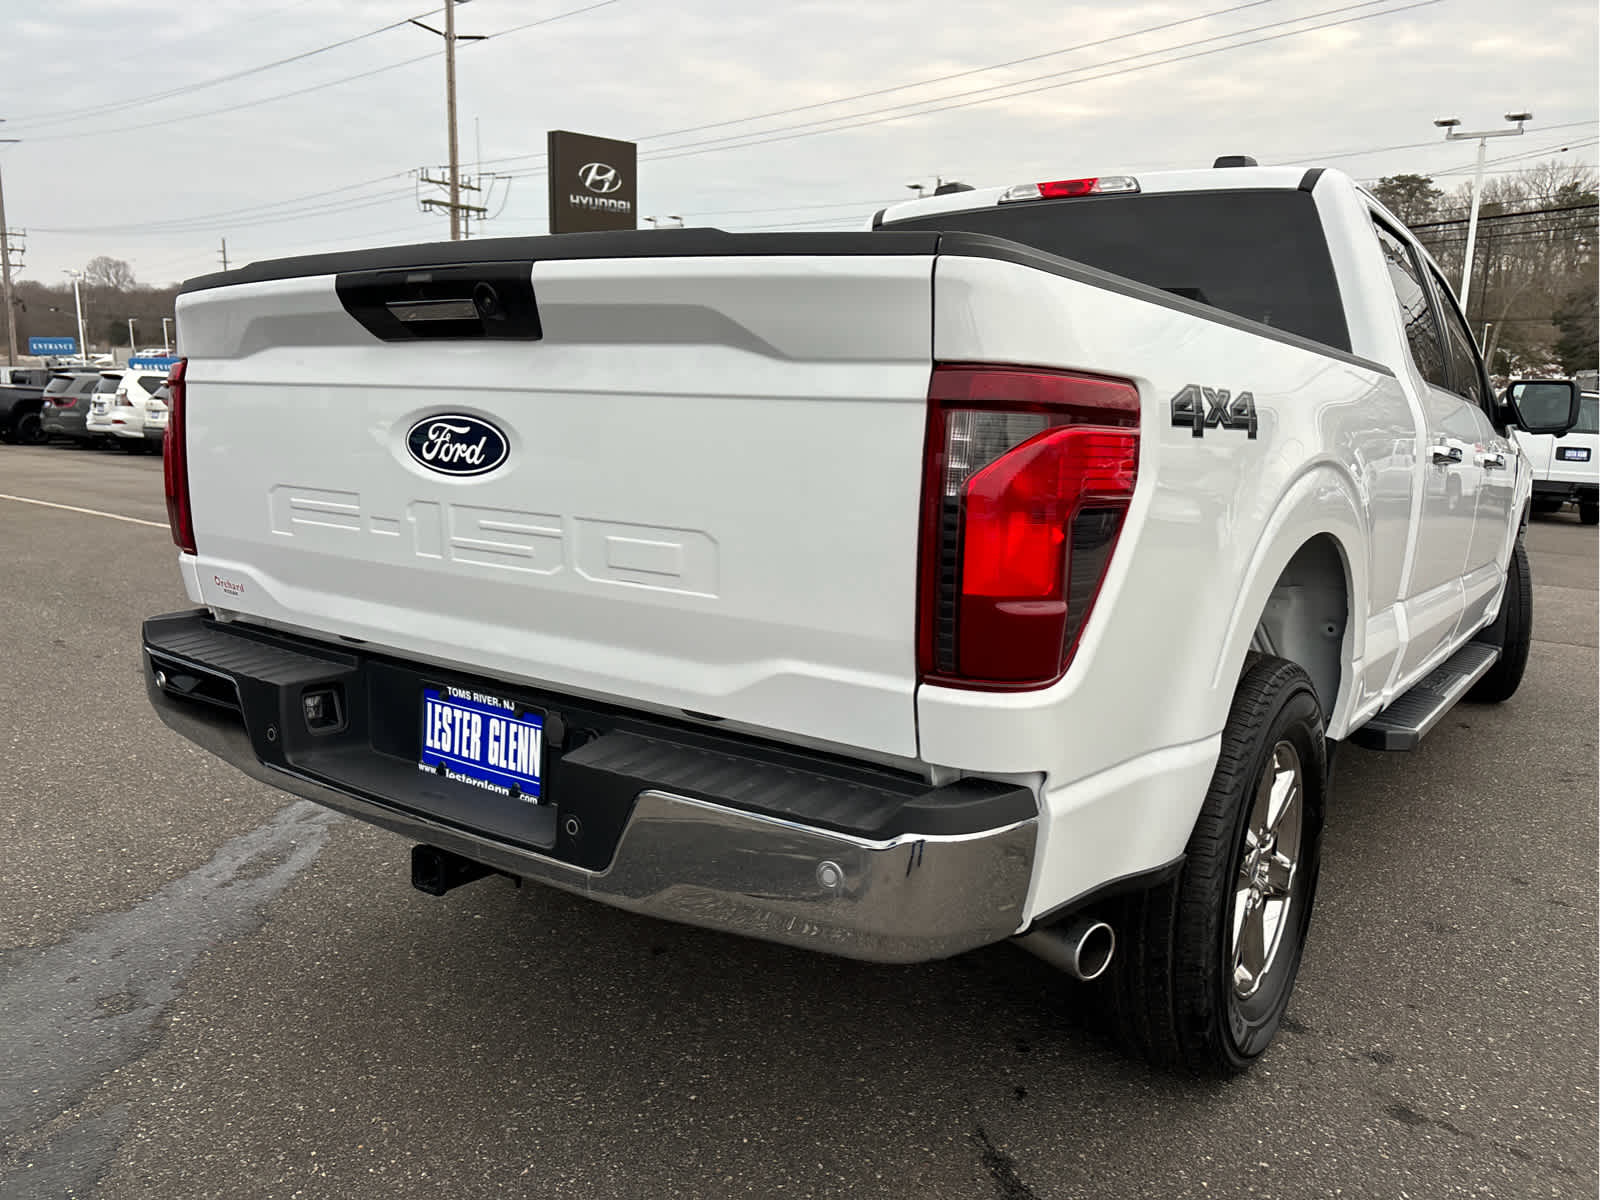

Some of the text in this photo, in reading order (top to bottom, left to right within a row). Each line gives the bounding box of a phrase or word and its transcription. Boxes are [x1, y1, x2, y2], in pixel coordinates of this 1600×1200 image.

[570, 194, 631, 213] HYUNDAI
[422, 422, 488, 465] Ford
[269, 484, 719, 598] F-150
[214, 575, 245, 592] Orchard
[447, 686, 472, 701] TOMS
[503, 700, 516, 711] NJ
[426, 701, 542, 778] LESTER GLENN
